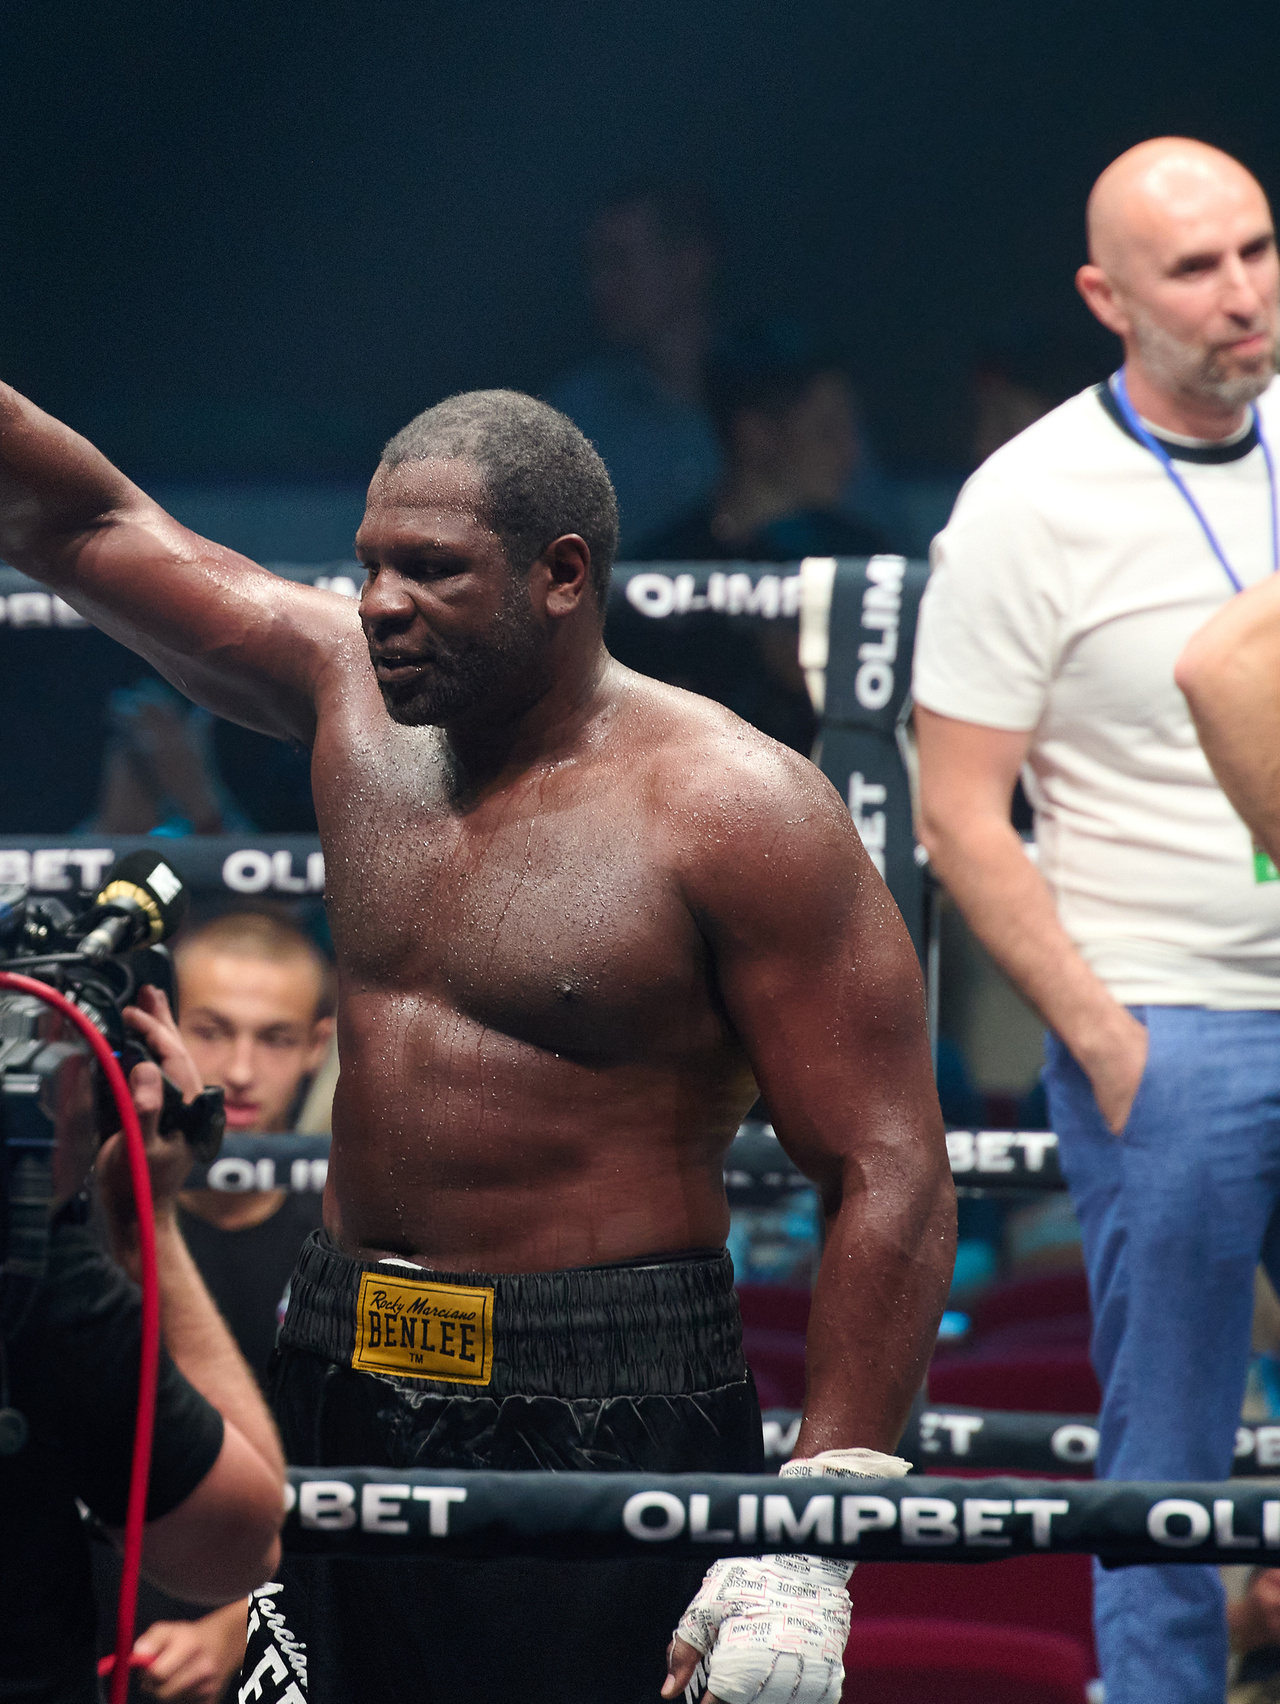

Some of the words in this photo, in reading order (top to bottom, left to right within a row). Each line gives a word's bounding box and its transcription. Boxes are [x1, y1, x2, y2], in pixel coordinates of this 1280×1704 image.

[370, 1290, 405, 1317] Rocky
[406, 1296, 477, 1321] Marciano
[368, 1310, 476, 1363] BENLEE
[409, 1352, 424, 1364] TM
[623, 1490, 1070, 1548] OLIMPBET
